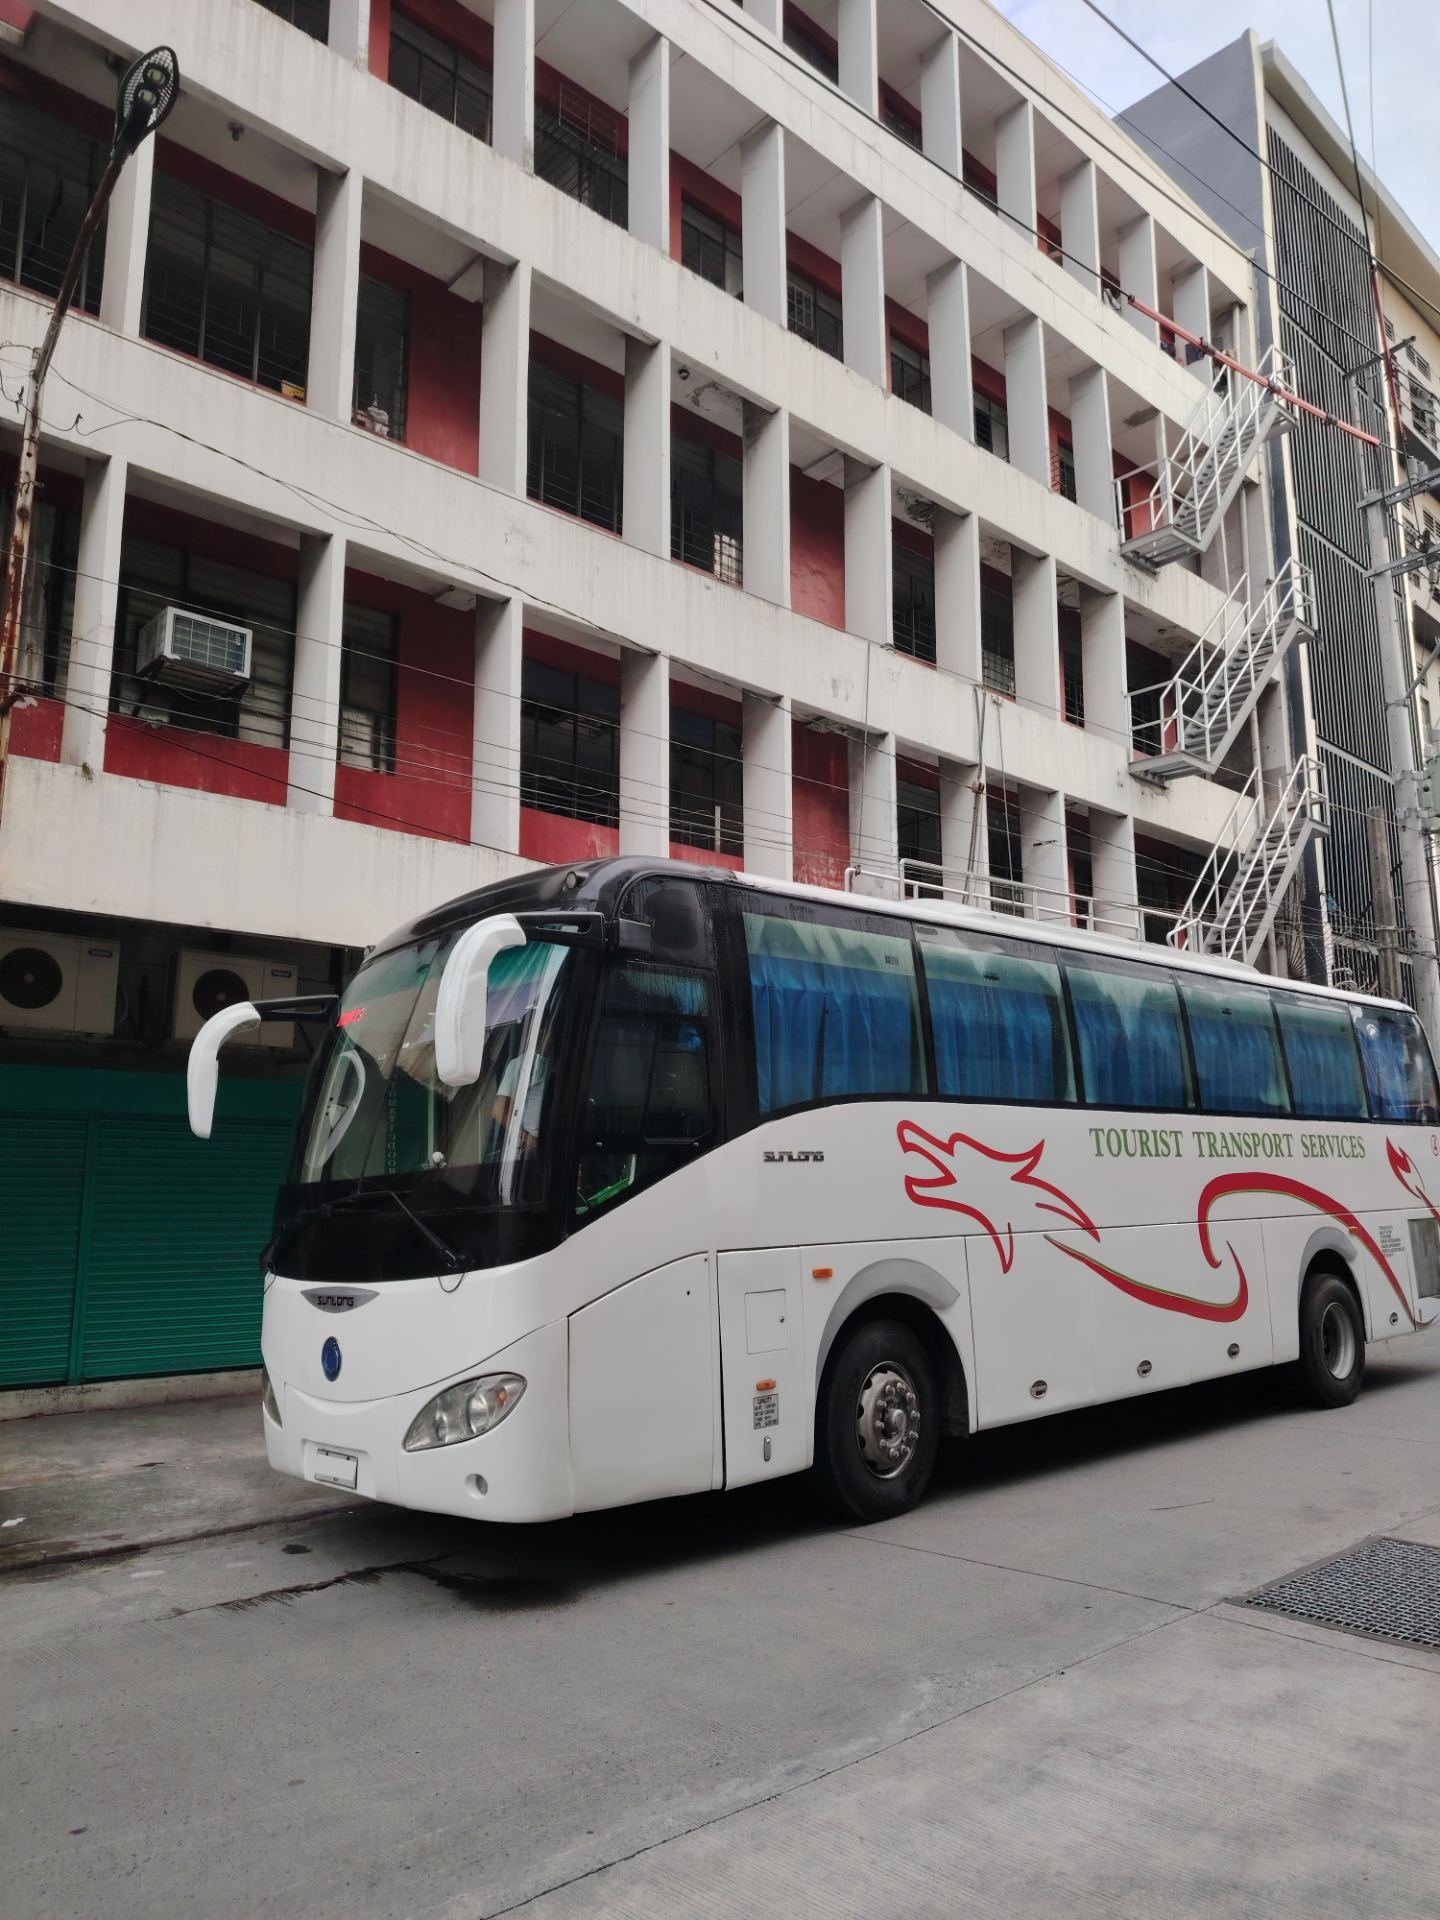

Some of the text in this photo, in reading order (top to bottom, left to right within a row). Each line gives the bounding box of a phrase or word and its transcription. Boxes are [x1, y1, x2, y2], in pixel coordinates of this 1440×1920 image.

[1088, 1128, 1366, 1158] TOURIST TRANSPORT SERVICES
[763, 1151, 824, 1162] SUNLONG
[317, 1296, 354, 1306] SUNLONG
